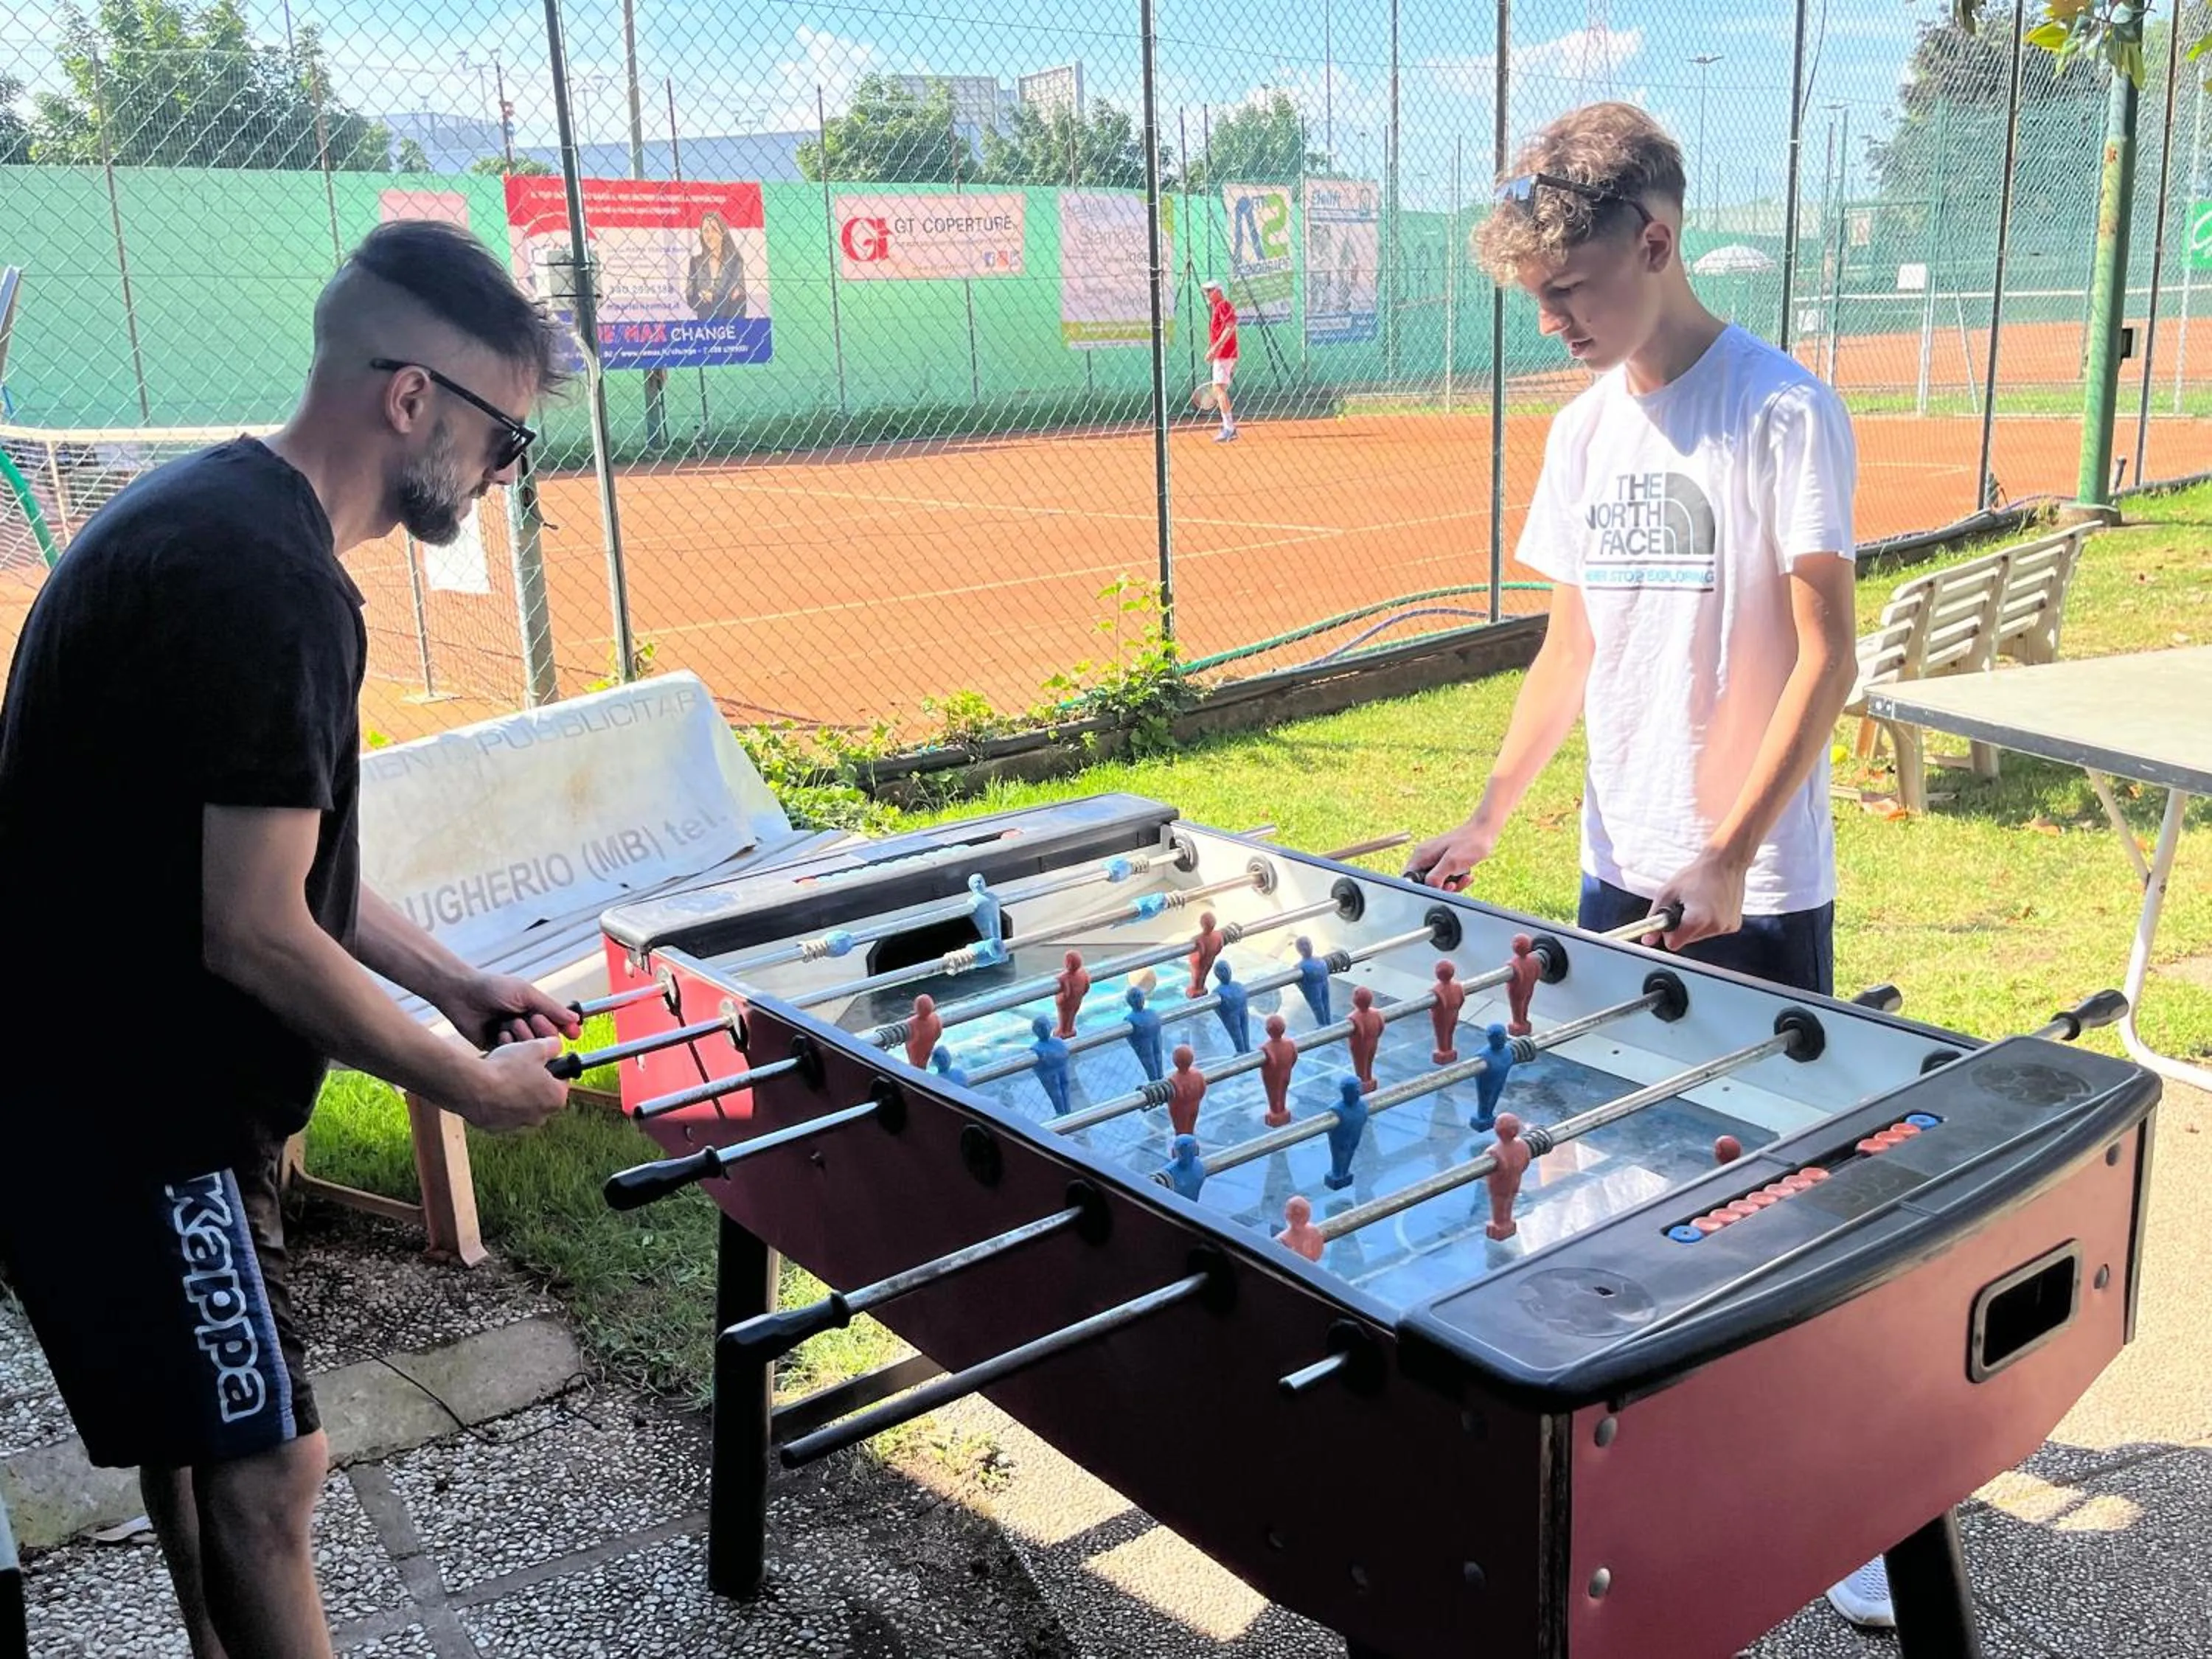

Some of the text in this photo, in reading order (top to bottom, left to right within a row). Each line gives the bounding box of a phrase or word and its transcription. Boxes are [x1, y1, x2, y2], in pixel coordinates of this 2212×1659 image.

[894, 215, 1012, 234] GT COPERTURE
[670, 325, 737, 341] CHANGE
[1616, 473, 1663, 500] THE
[1599, 529, 1662, 556] FACE
[393, 852, 575, 932] UGHERIO
[579, 826, 662, 882] (MB)
[164, 1171, 266, 1423] Kappa
